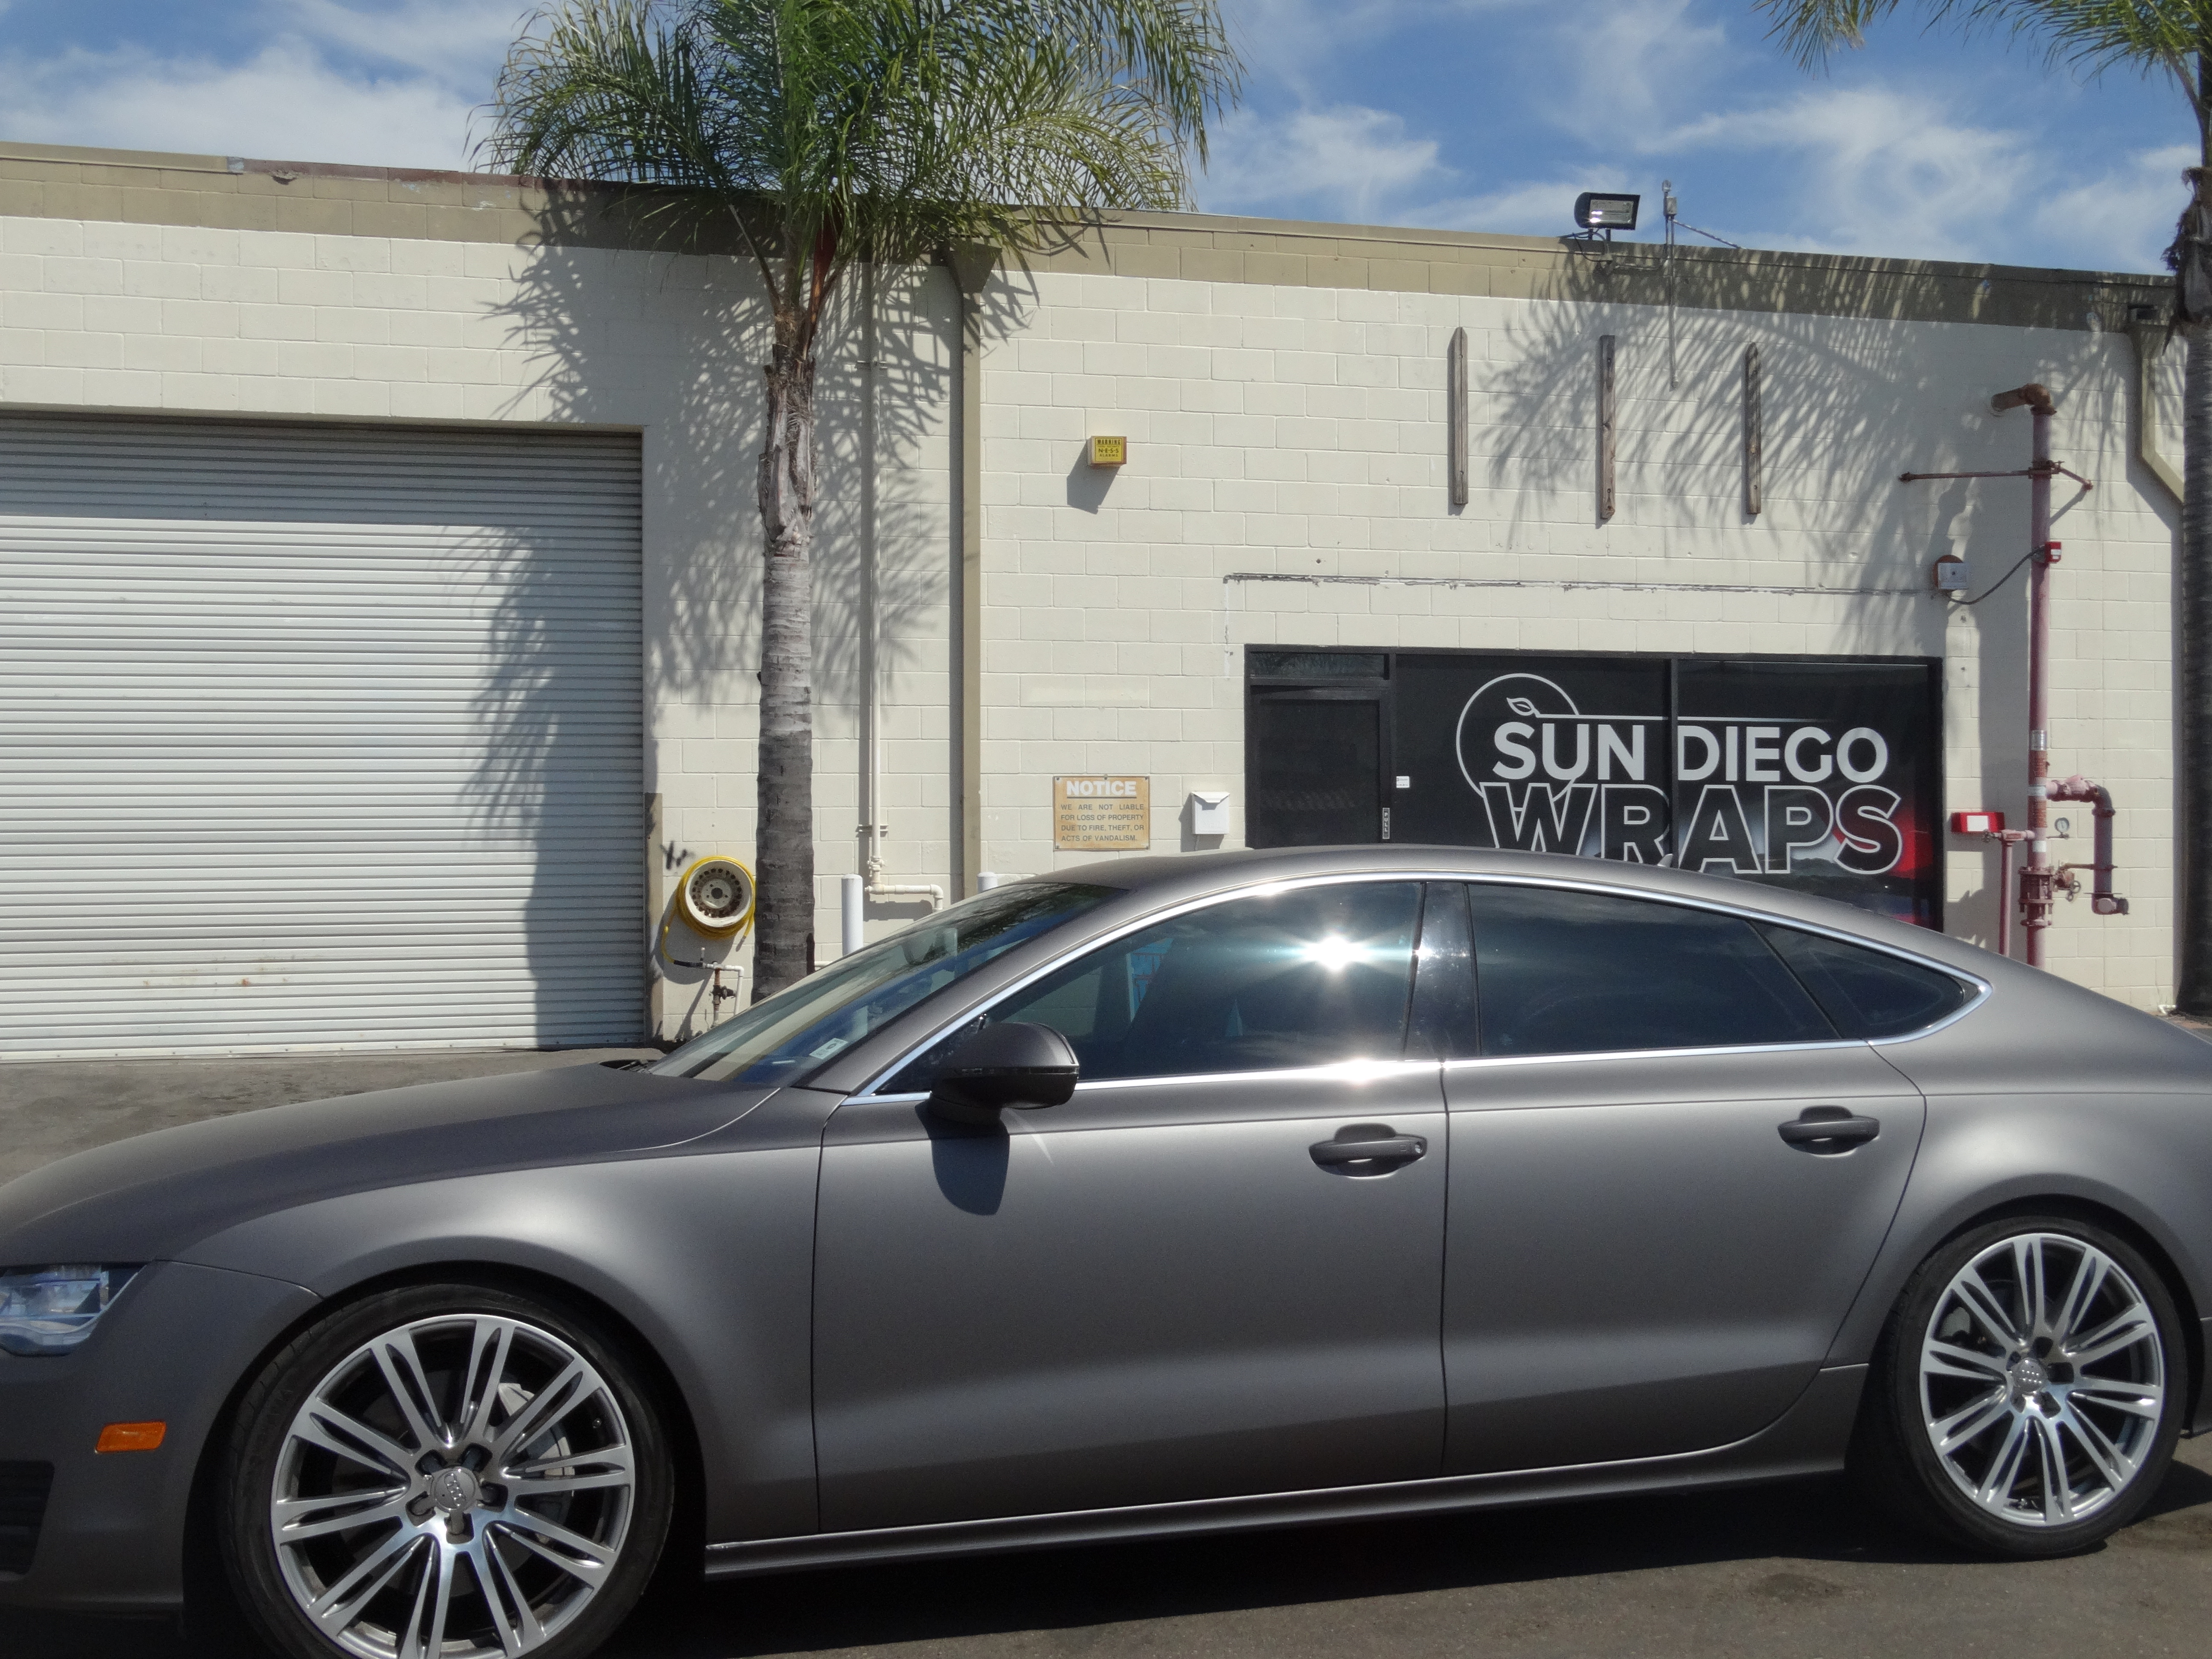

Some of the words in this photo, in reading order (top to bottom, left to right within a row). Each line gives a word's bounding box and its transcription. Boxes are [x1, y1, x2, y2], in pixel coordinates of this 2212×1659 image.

[1493, 722, 1644, 780] SUN
[1677, 725, 1888, 783] DIEGO
[1067, 780, 1137, 795] NOTICE
[1479, 782, 1902, 874] WRAPS
